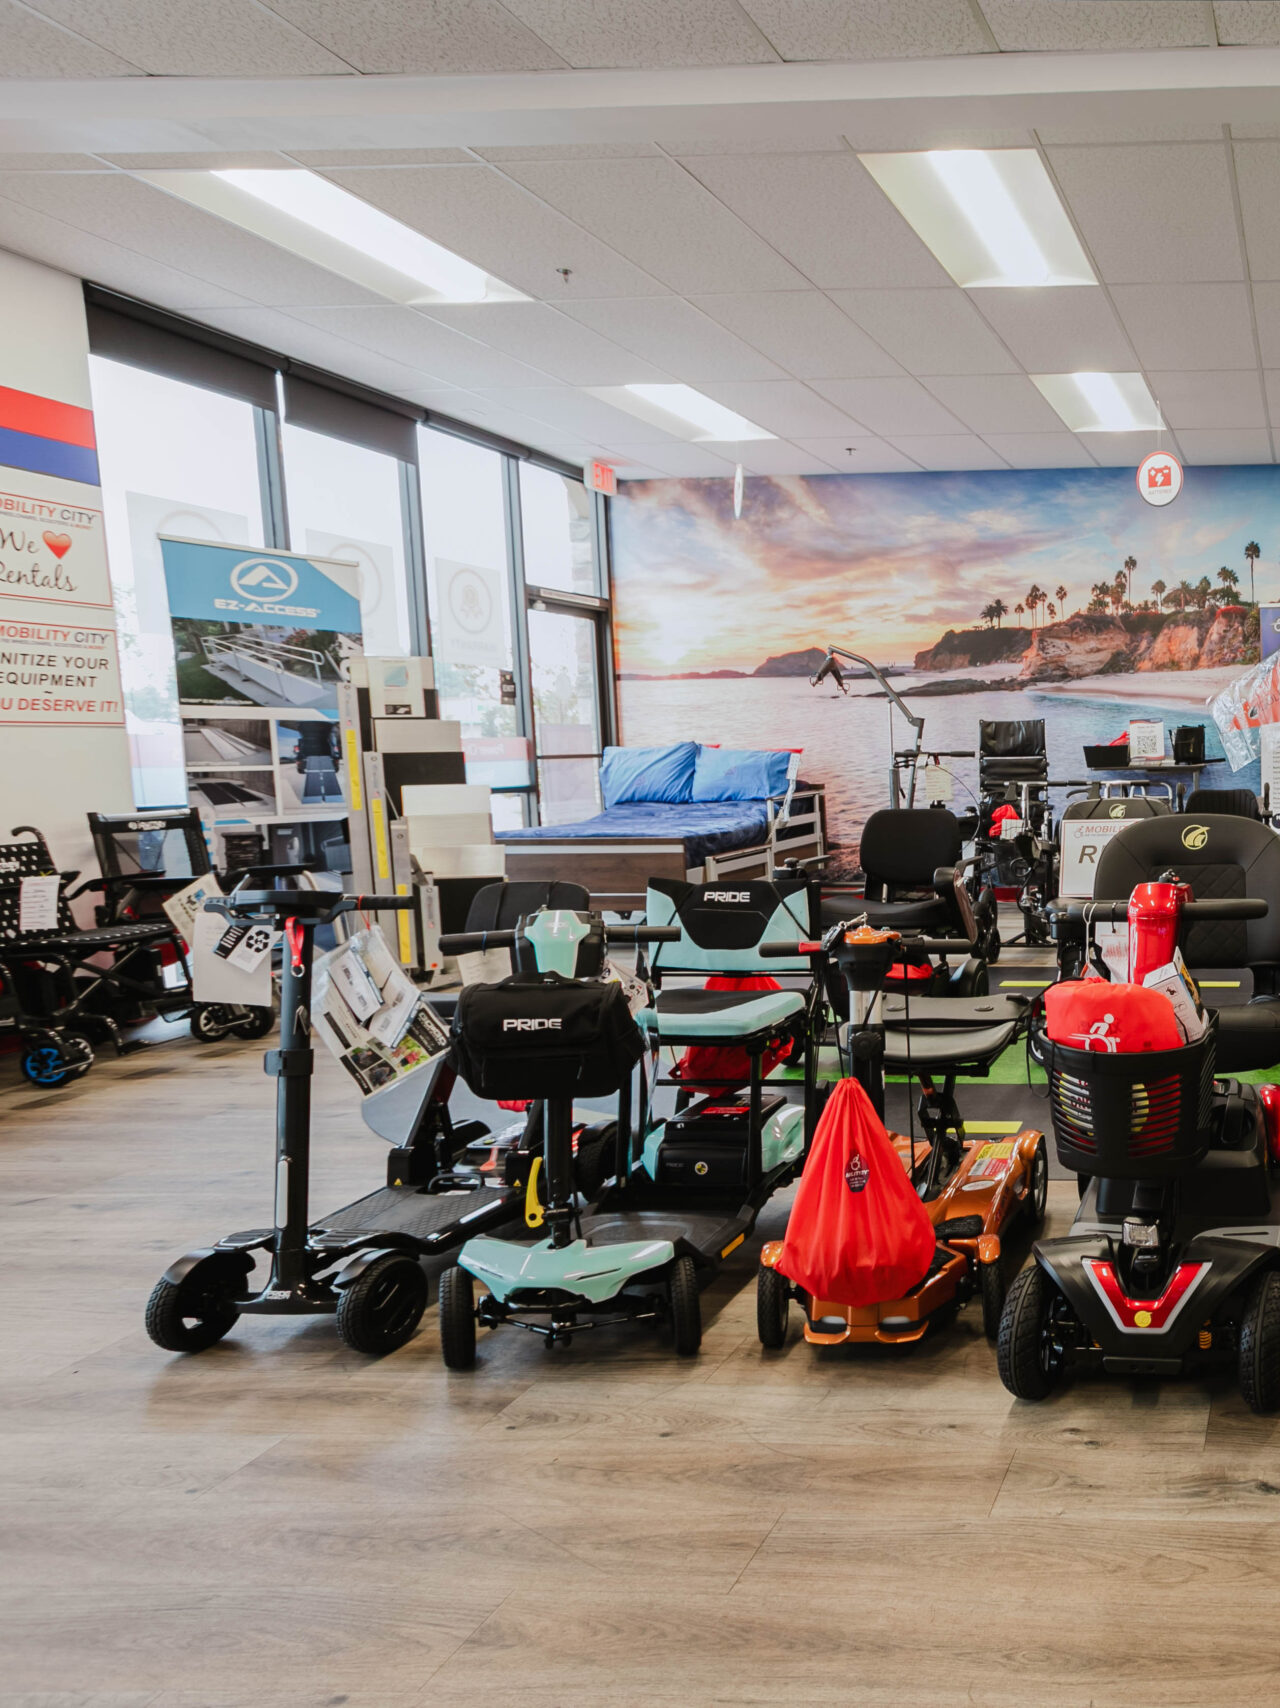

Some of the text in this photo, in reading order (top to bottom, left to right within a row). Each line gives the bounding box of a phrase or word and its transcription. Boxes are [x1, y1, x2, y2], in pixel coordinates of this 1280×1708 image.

[0, 498, 56, 517] BILITY
[60, 509, 96, 525] CITY
[74, 631, 109, 644] CITY
[63, 655, 109, 670] YOUR
[17, 698, 96, 712] DESERVE
[100, 700, 118, 712] IT!
[703, 891, 750, 902] PRIDE
[503, 1018, 562, 1031] PRIDE
